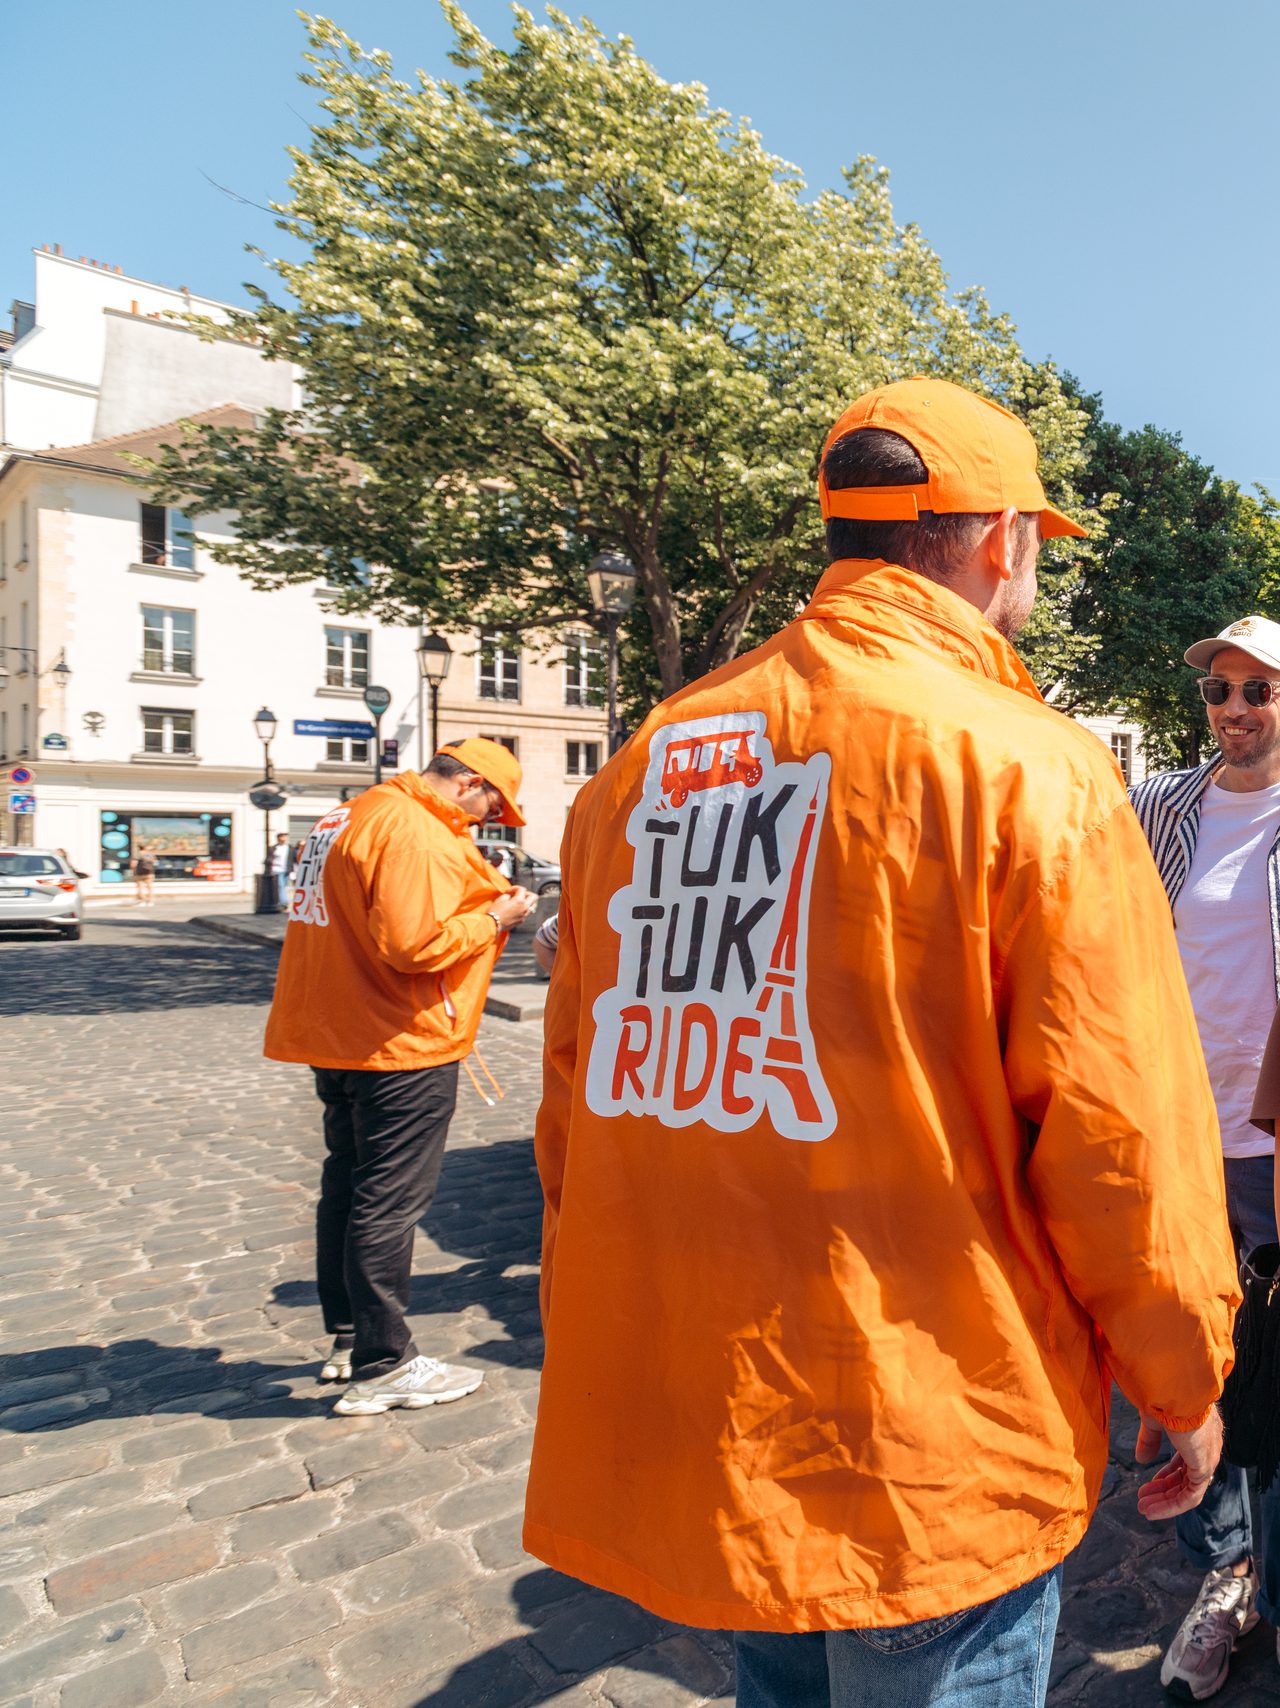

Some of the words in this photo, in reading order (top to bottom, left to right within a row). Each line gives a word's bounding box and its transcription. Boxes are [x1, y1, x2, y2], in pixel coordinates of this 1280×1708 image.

[645, 784, 797, 898] TUK
[632, 896, 776, 998] TUK
[611, 1002, 761, 1114] RIDE
